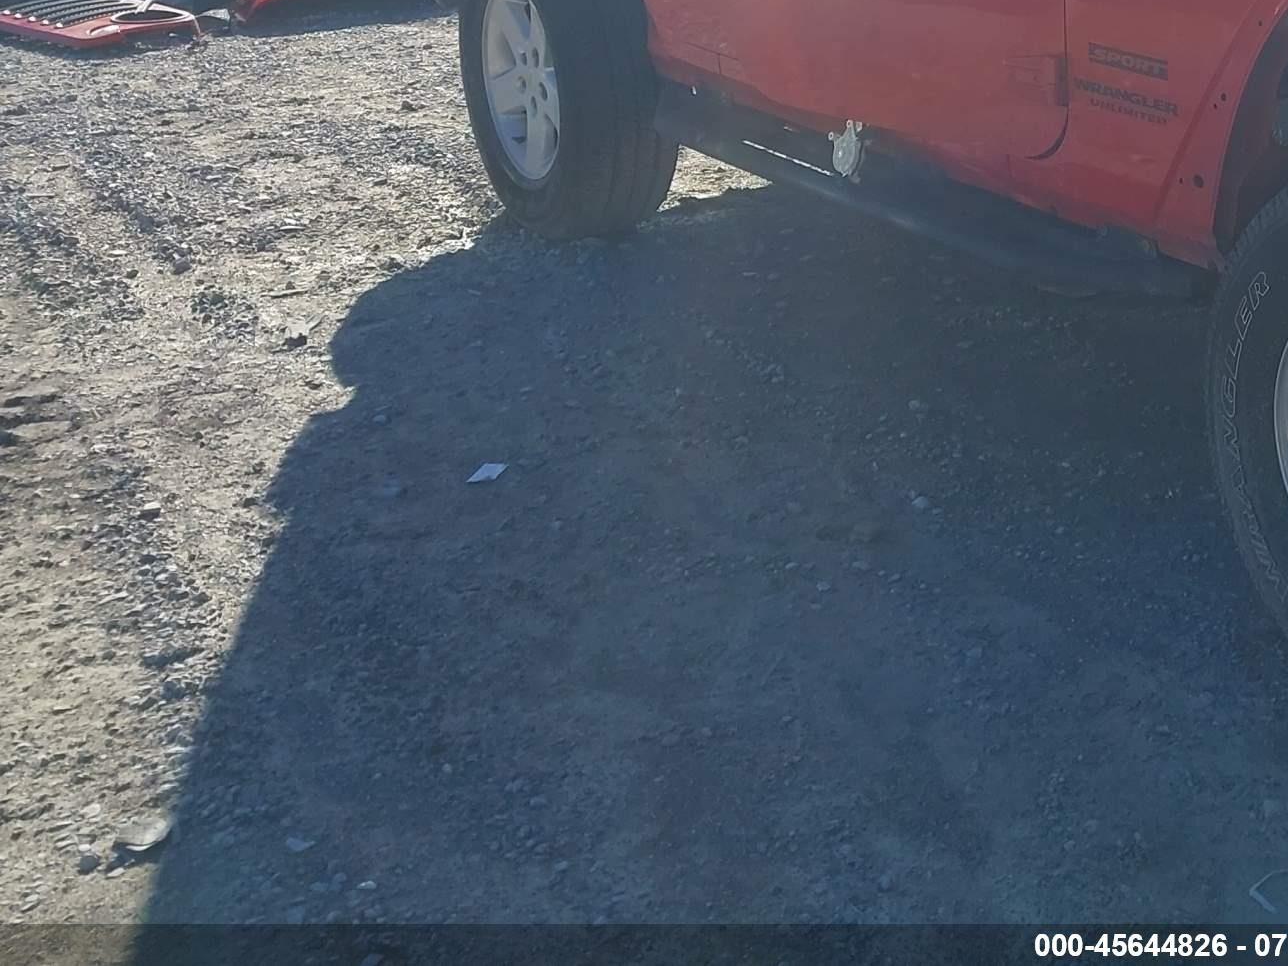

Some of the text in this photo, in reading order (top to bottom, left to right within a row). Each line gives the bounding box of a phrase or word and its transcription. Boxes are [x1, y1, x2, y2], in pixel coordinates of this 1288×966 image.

[1091, 47, 1162, 76] SPORT
[1075, 78, 1177, 115] WRANGLER
[1090, 98, 1167, 125] UNLIMITED
